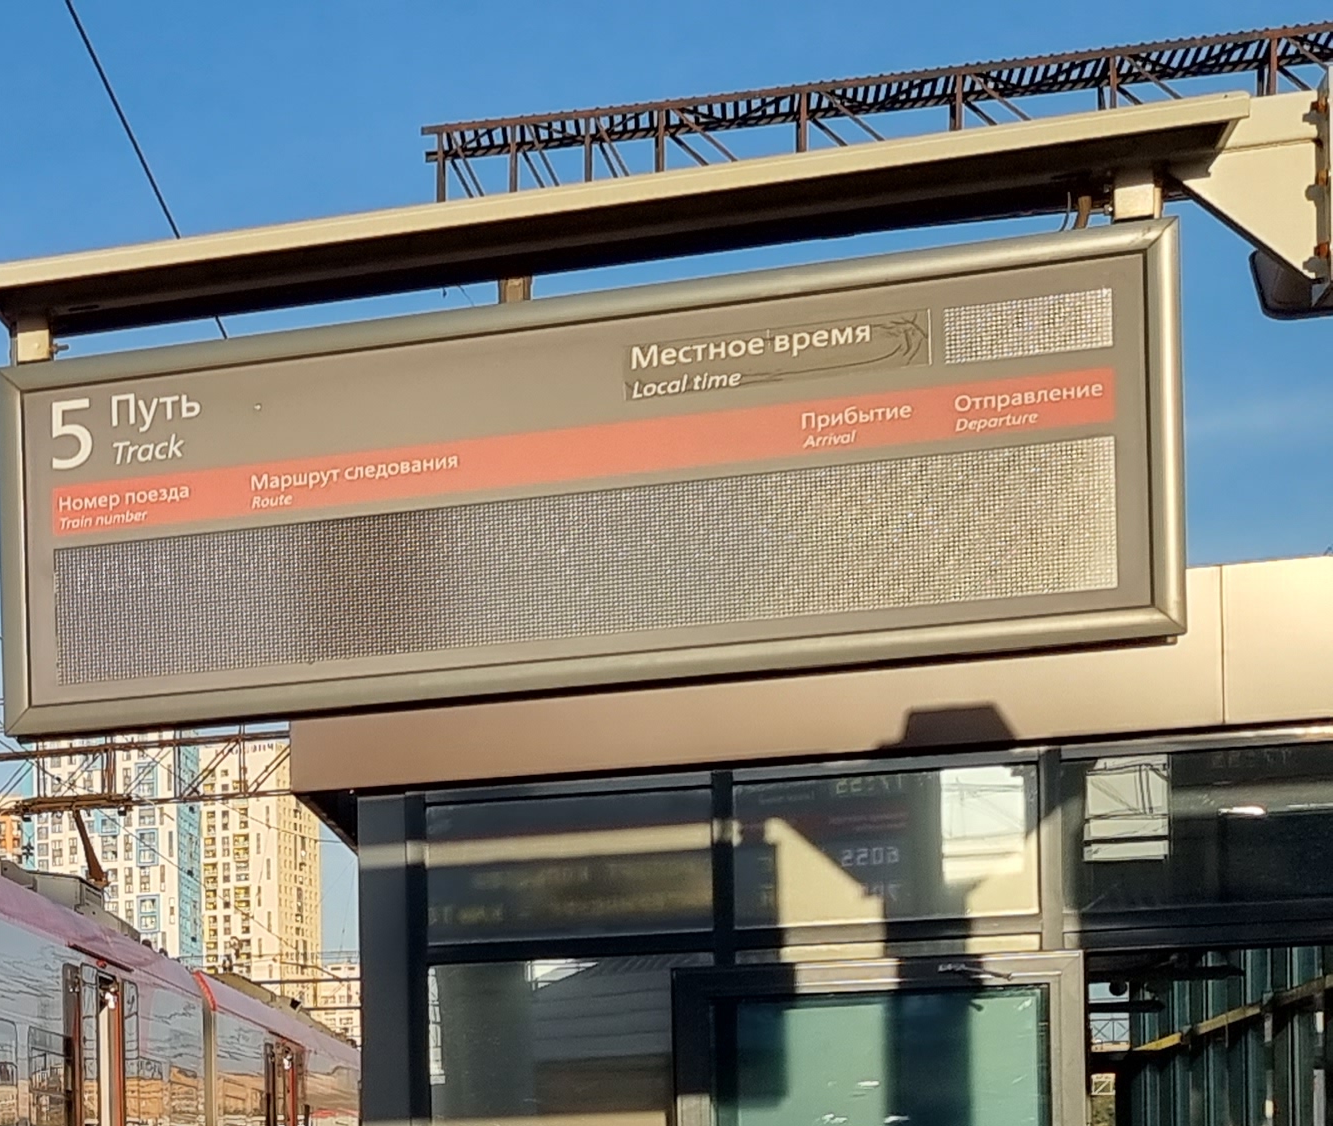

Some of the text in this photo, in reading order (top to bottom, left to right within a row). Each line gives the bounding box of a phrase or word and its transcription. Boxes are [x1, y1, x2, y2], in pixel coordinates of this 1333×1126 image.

[630, 324, 872, 370] Местное время
[632, 372, 742, 399] Local time
[954, 382, 1103, 412] Отправление
[52, 393, 201, 469] 5 Путь
[801, 404, 913, 432] Прибытие
[955, 411, 1039, 433] Departure
[113, 433, 184, 464] Track
[803, 430, 856, 449] Arrival
[251, 455, 458, 491] Маршрут следования
[59, 486, 190, 512] Номер поезда
[251, 493, 293, 509] Route
[60, 510, 148, 530] Train number
